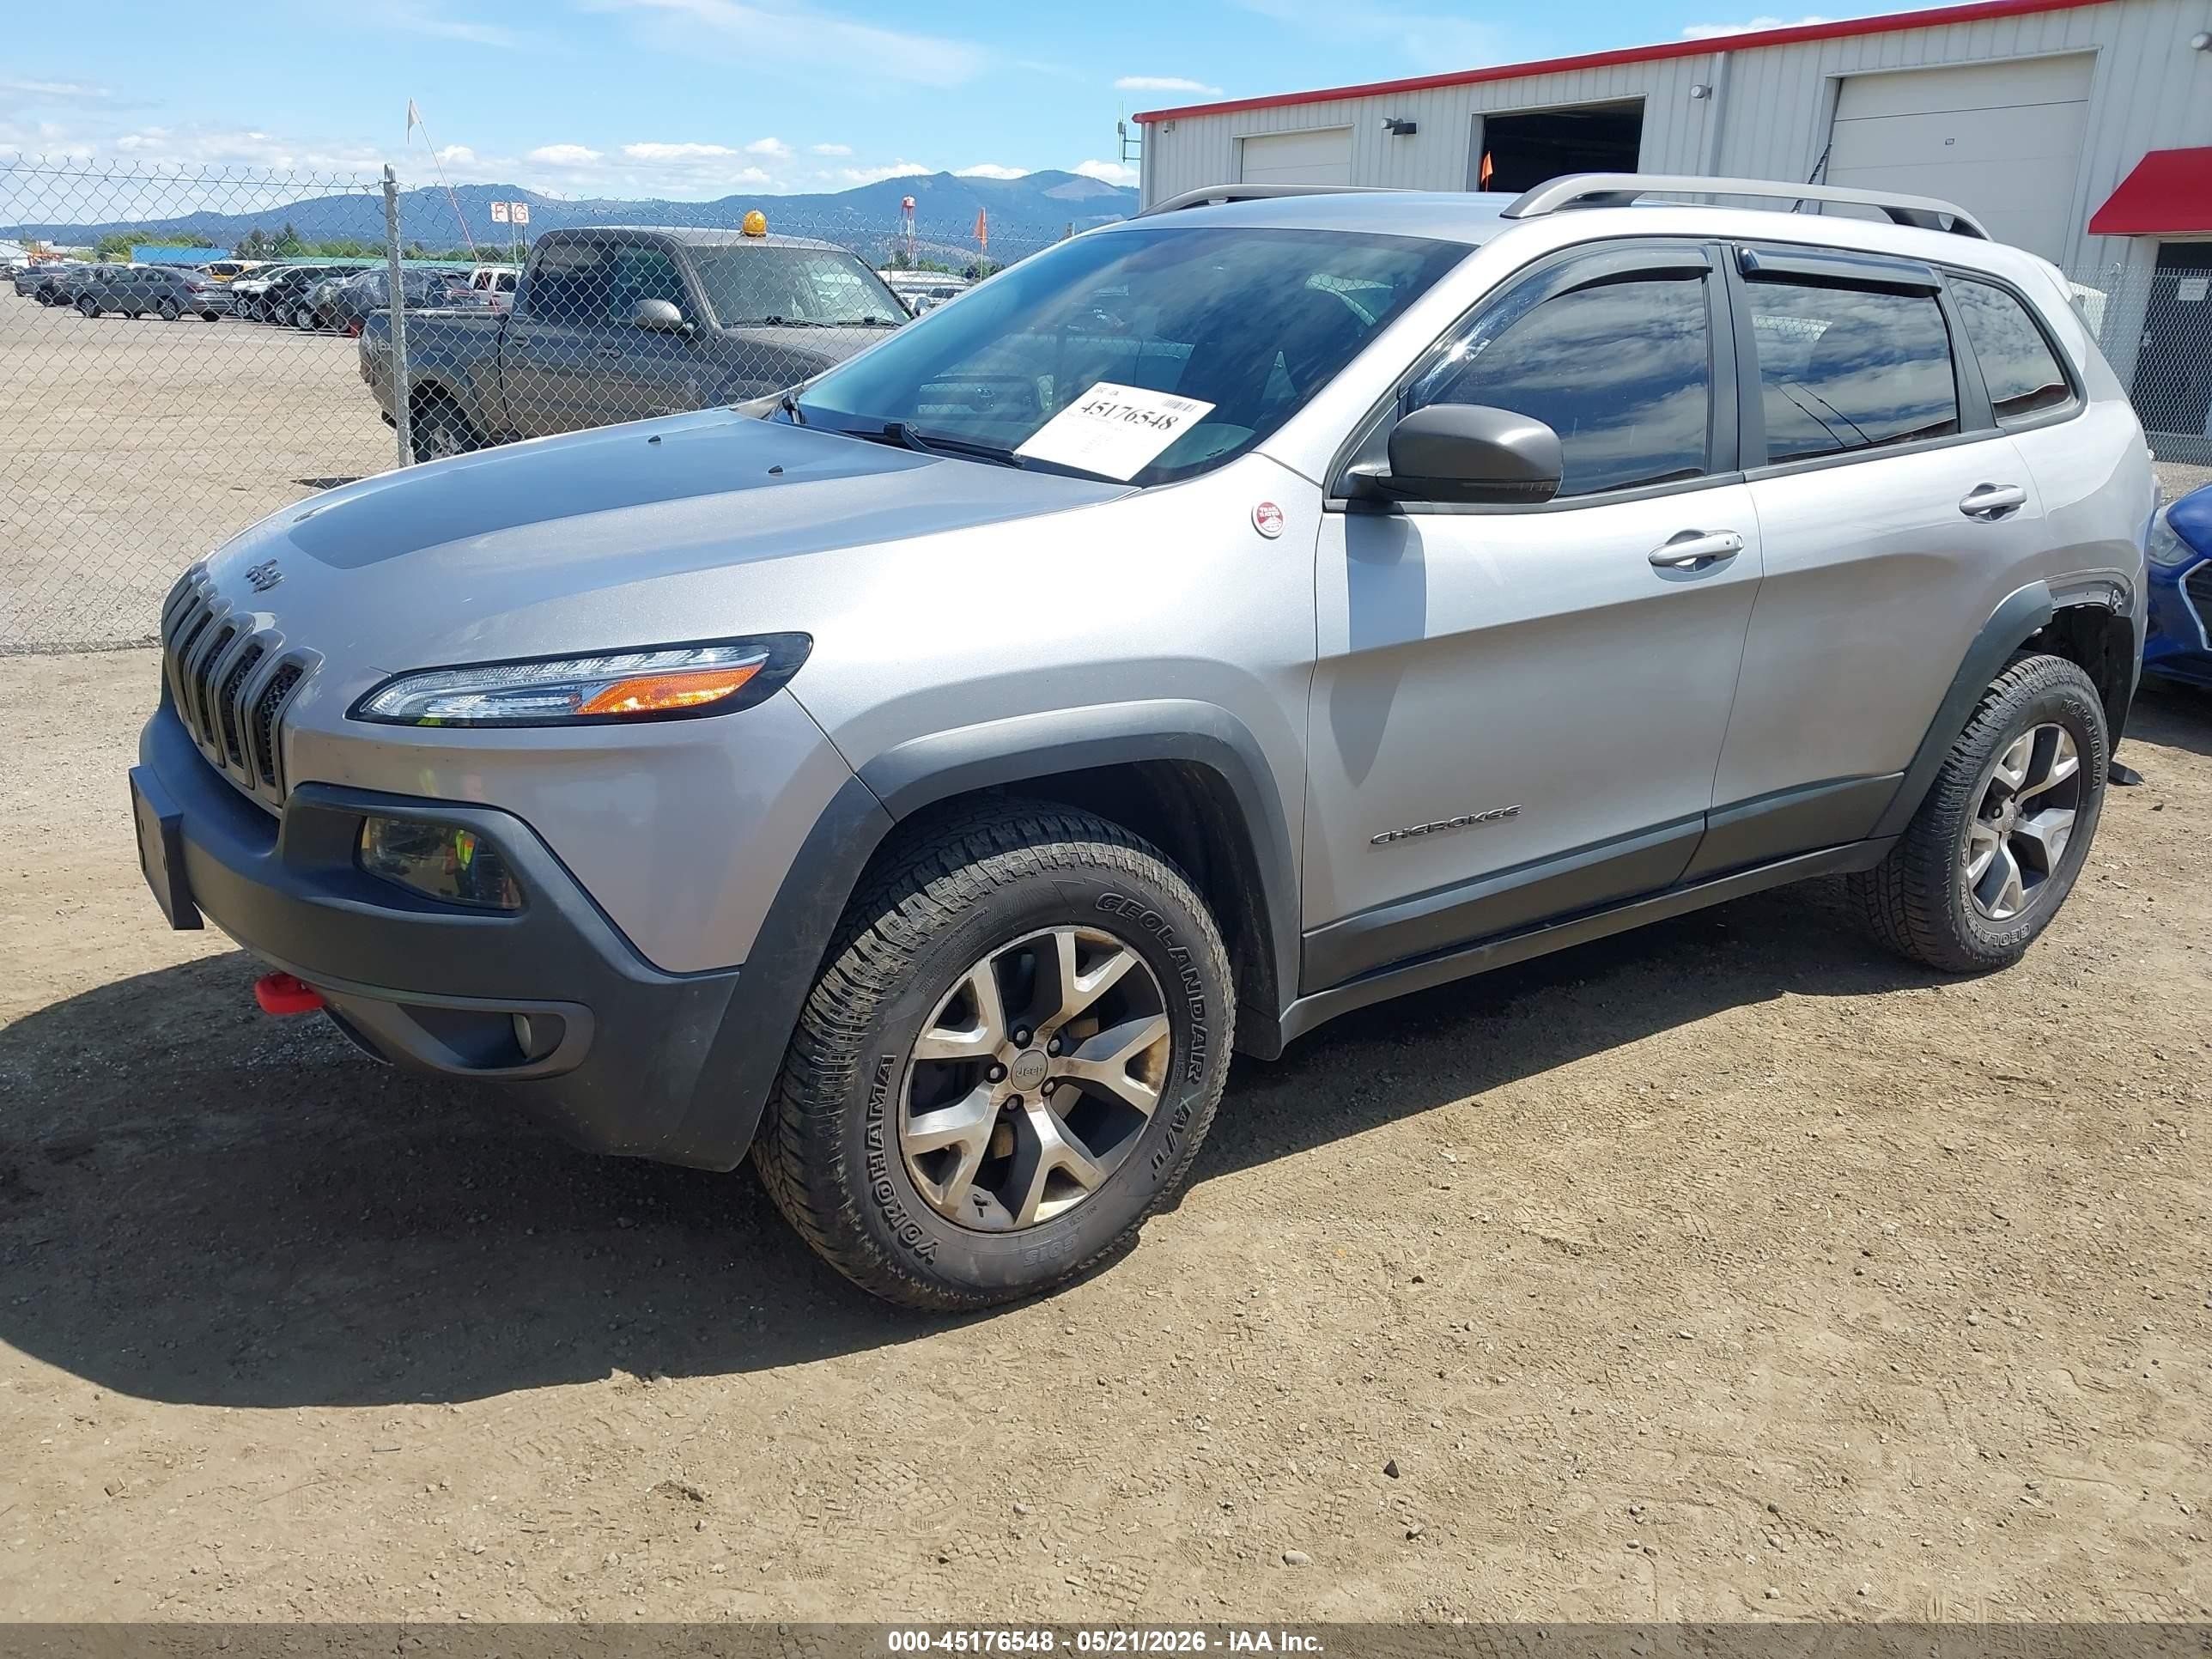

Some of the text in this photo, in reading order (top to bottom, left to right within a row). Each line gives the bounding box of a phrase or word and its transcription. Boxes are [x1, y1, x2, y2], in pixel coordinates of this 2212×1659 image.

[495, 203, 526, 221] F G
[1080, 399, 1179, 430] 45176548
[1370, 804, 1522, 845] CHEROKEE
[1094, 892, 1208, 1087] GEOLANDAR
[865, 1054, 940, 1267] YOKOHAMA
